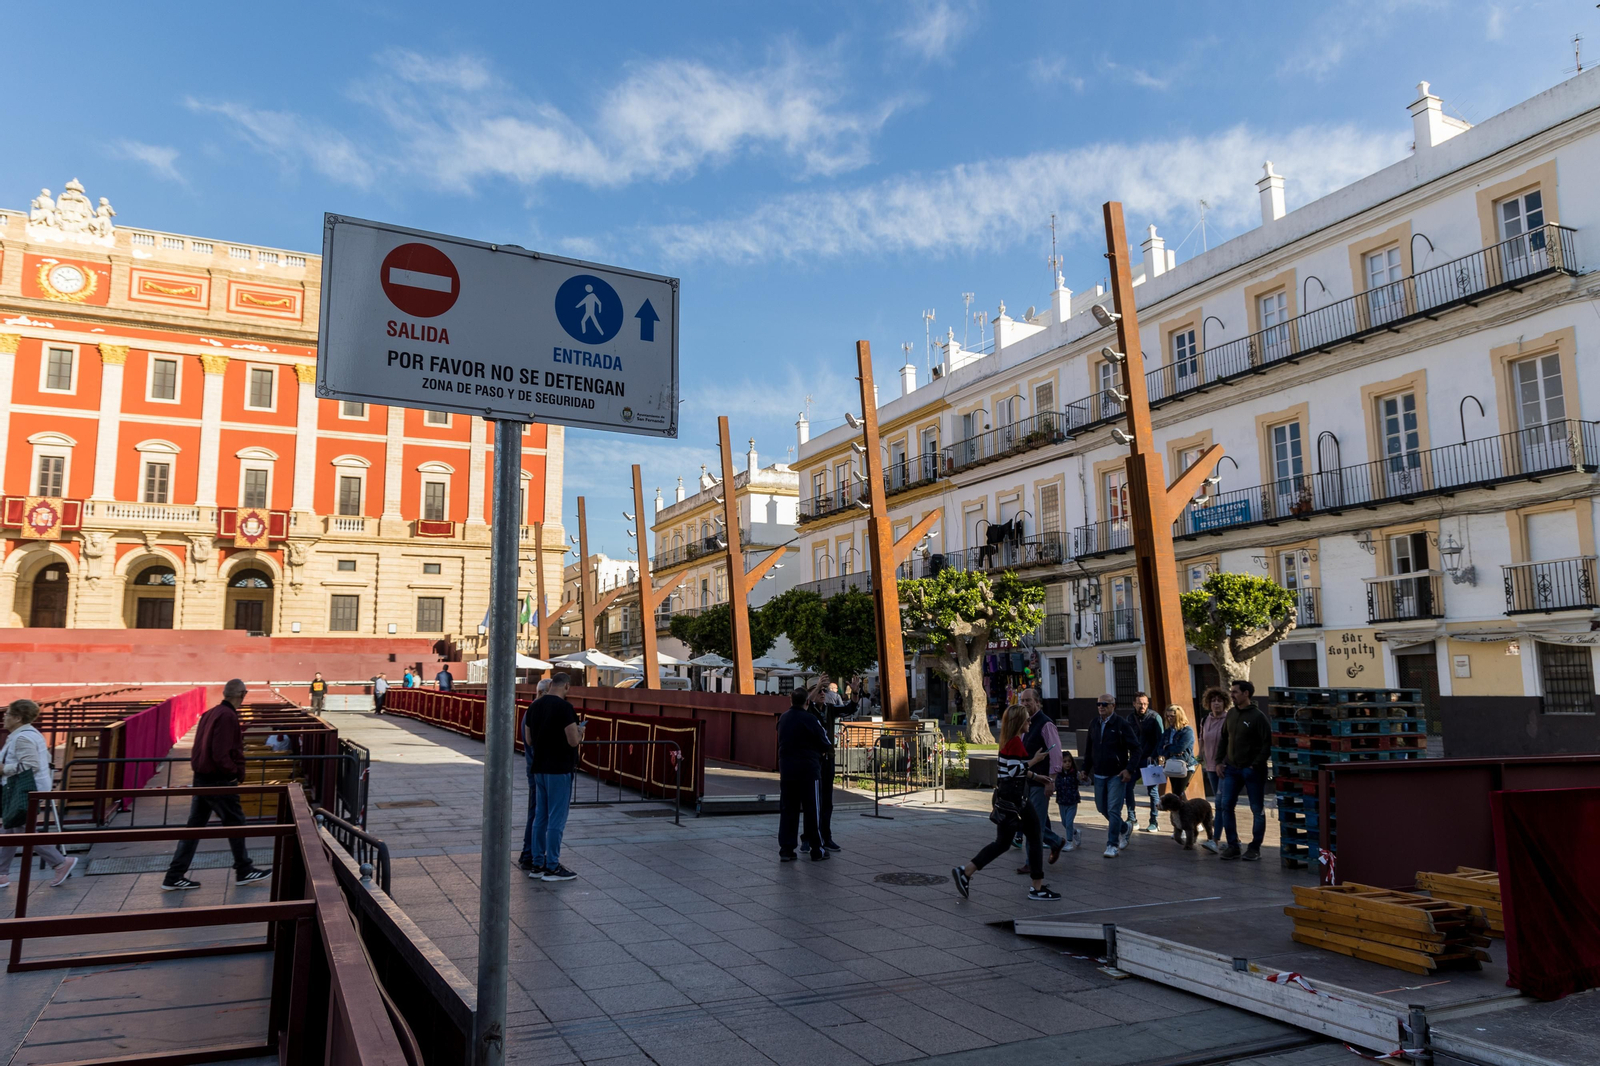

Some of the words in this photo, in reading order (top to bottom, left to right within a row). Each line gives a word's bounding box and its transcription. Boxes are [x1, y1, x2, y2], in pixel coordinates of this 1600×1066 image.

[386, 320, 450, 345] SALIDA
[553, 347, 623, 372] ENTRADA
[387, 350, 424, 371] POR
[430, 356, 485, 379] FAVOR
[491, 364, 514, 383] NO
[519, 368, 539, 386] SE
[544, 371, 625, 397] DETENGAN
[422, 377, 454, 393] ZONA
[457, 382, 471, 395] DE
[475, 384, 504, 399] PASO
[508, 388, 514, 399] Y
[518, 389, 532, 401] DE
[535, 391, 595, 410] SEGURIDAD
[1342, 633, 1362, 645] Bar
